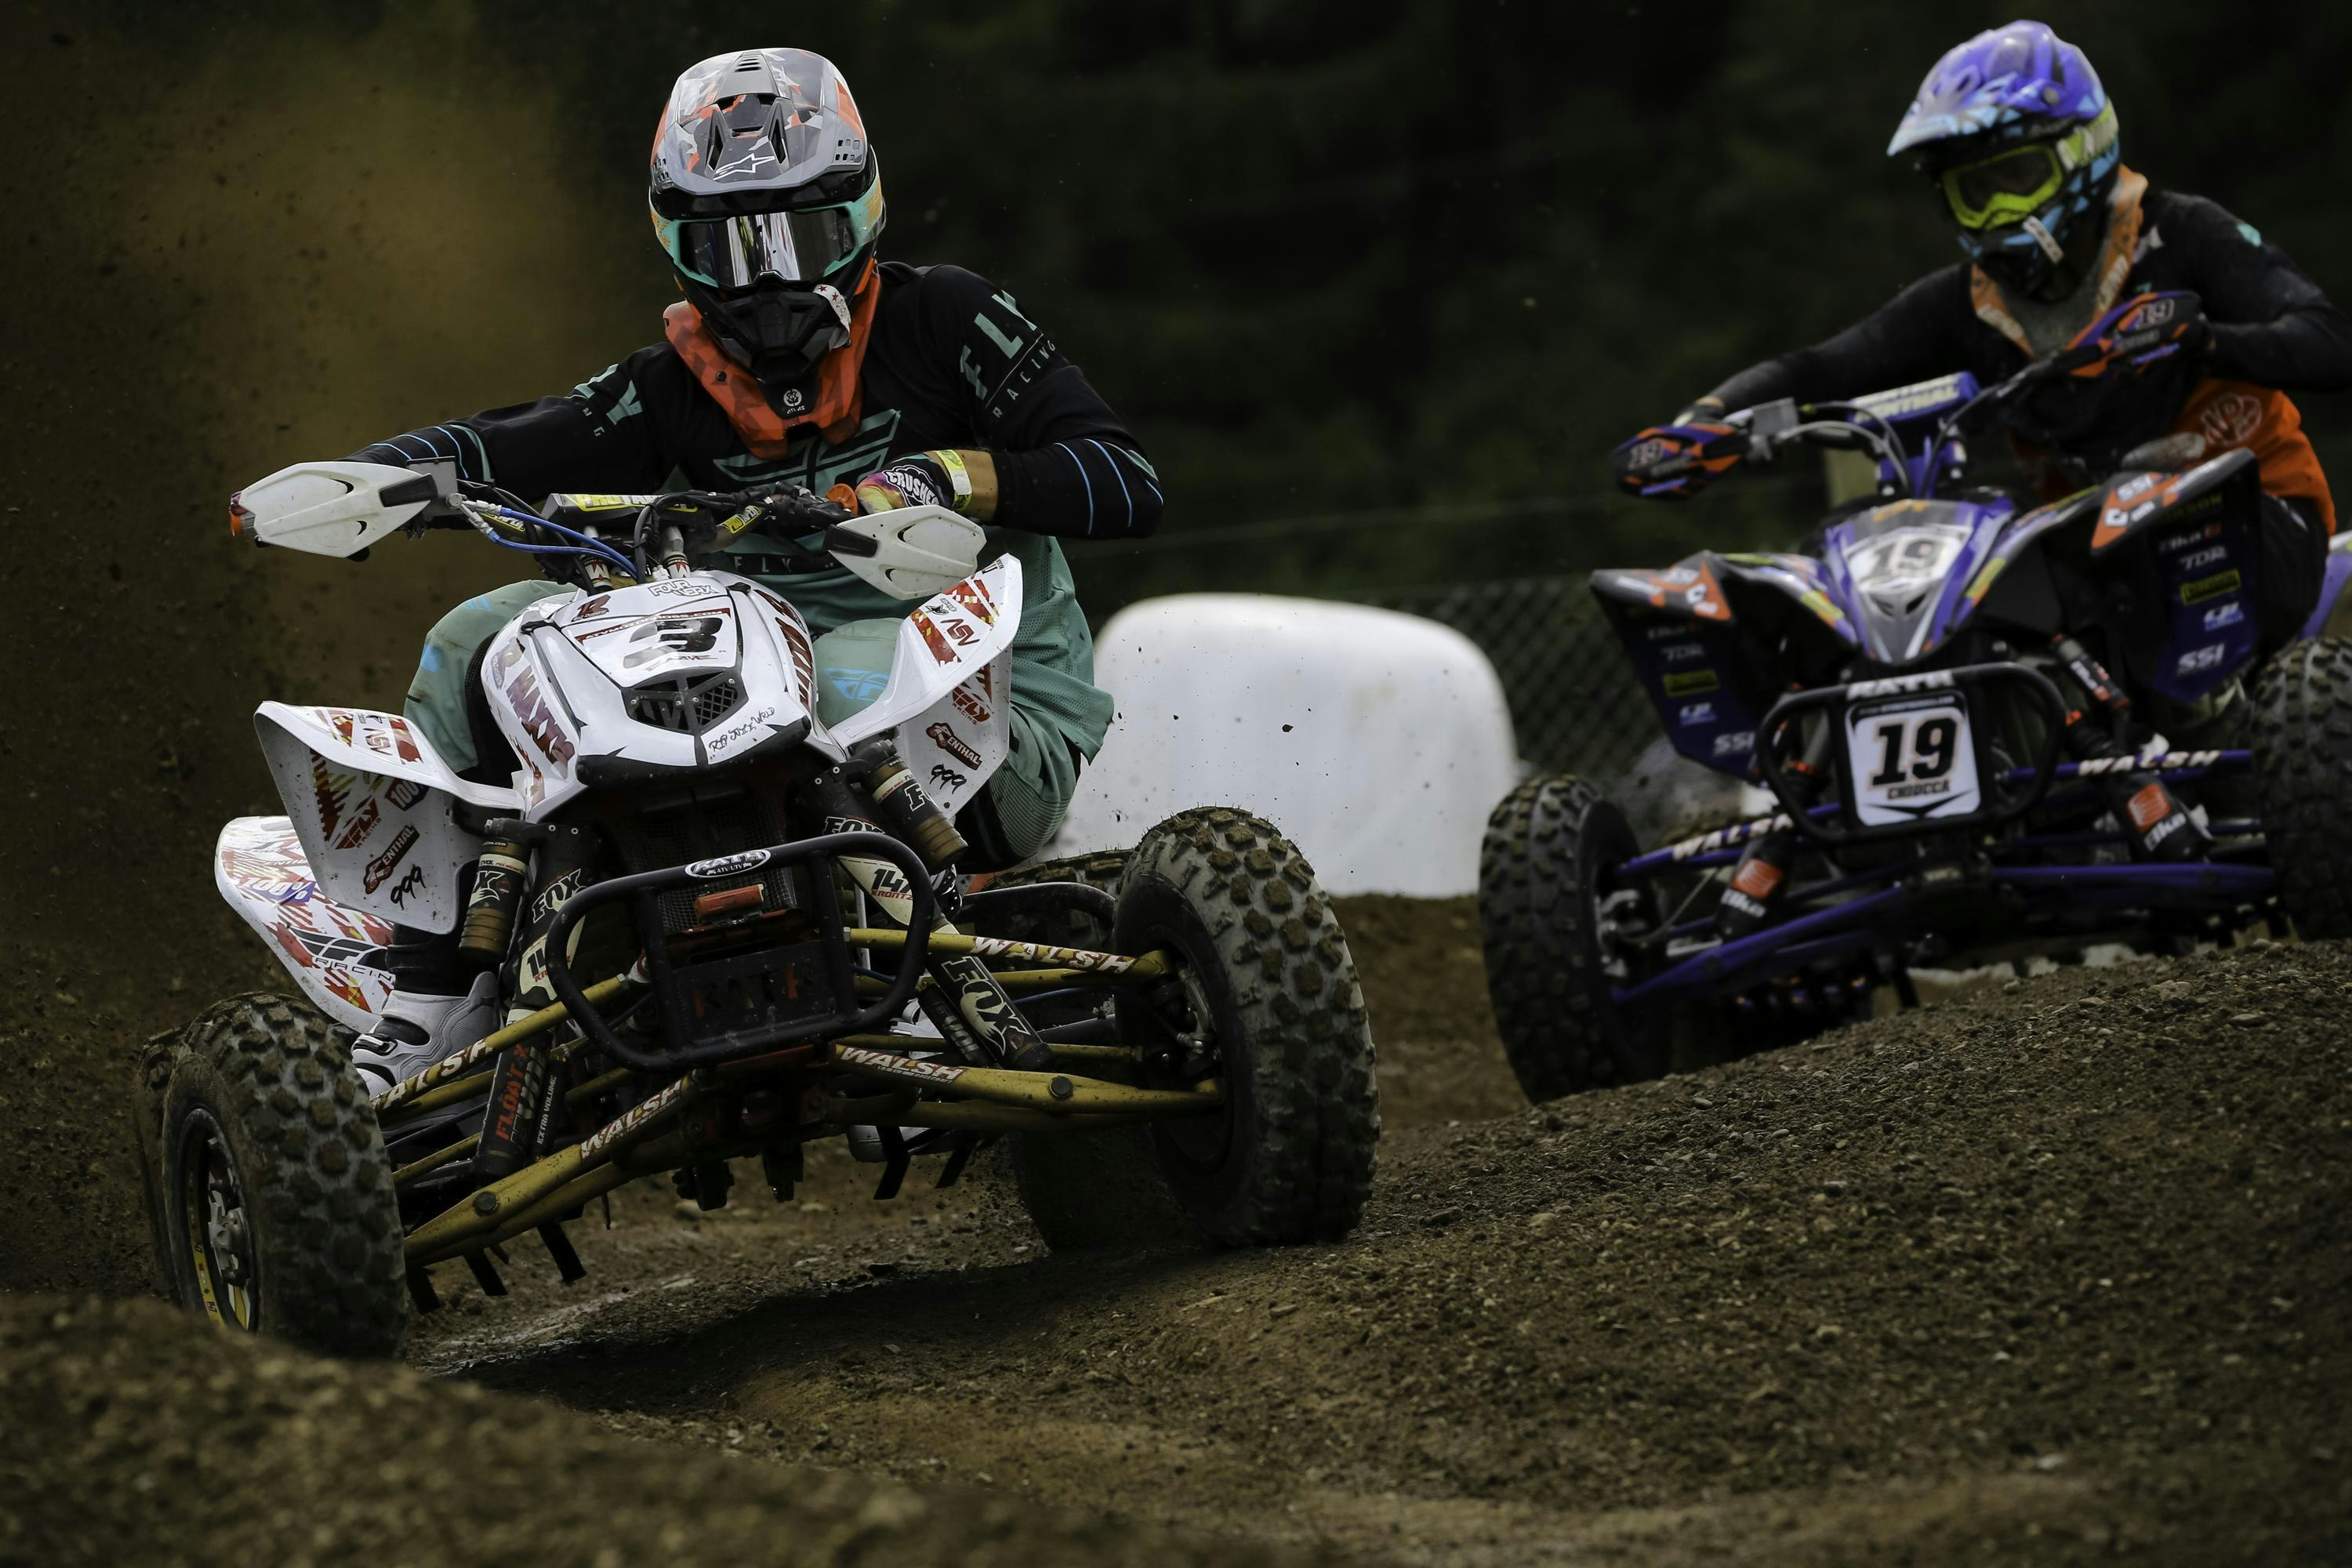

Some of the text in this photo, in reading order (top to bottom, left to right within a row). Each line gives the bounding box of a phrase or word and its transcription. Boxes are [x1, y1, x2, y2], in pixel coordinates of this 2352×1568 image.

[960, 289, 1037, 401] FLY
[993, 340, 1056, 418] RACING
[734, 555, 792, 573] FLY
[648, 580, 692, 597] FOUR
[672, 585, 719, 597] WERX
[623, 618, 723, 670] 3
[709, 730, 730, 752] RIP
[1873, 717, 1957, 786] 19
[390, 779, 423, 811] 100
[243, 877, 308, 900] 100%
[532, 868, 587, 924] FOX
[315, 957, 394, 982] RACIN
[970, 935, 1137, 975] WALSH
[941, 956, 1032, 1056] FOX
[840, 1047, 966, 1080] WALSH
[495, 1062, 527, 1141] FLOAT
[537, 1074, 557, 1145] EXTRA VOLUME
[581, 1078, 682, 1159] WALSH
